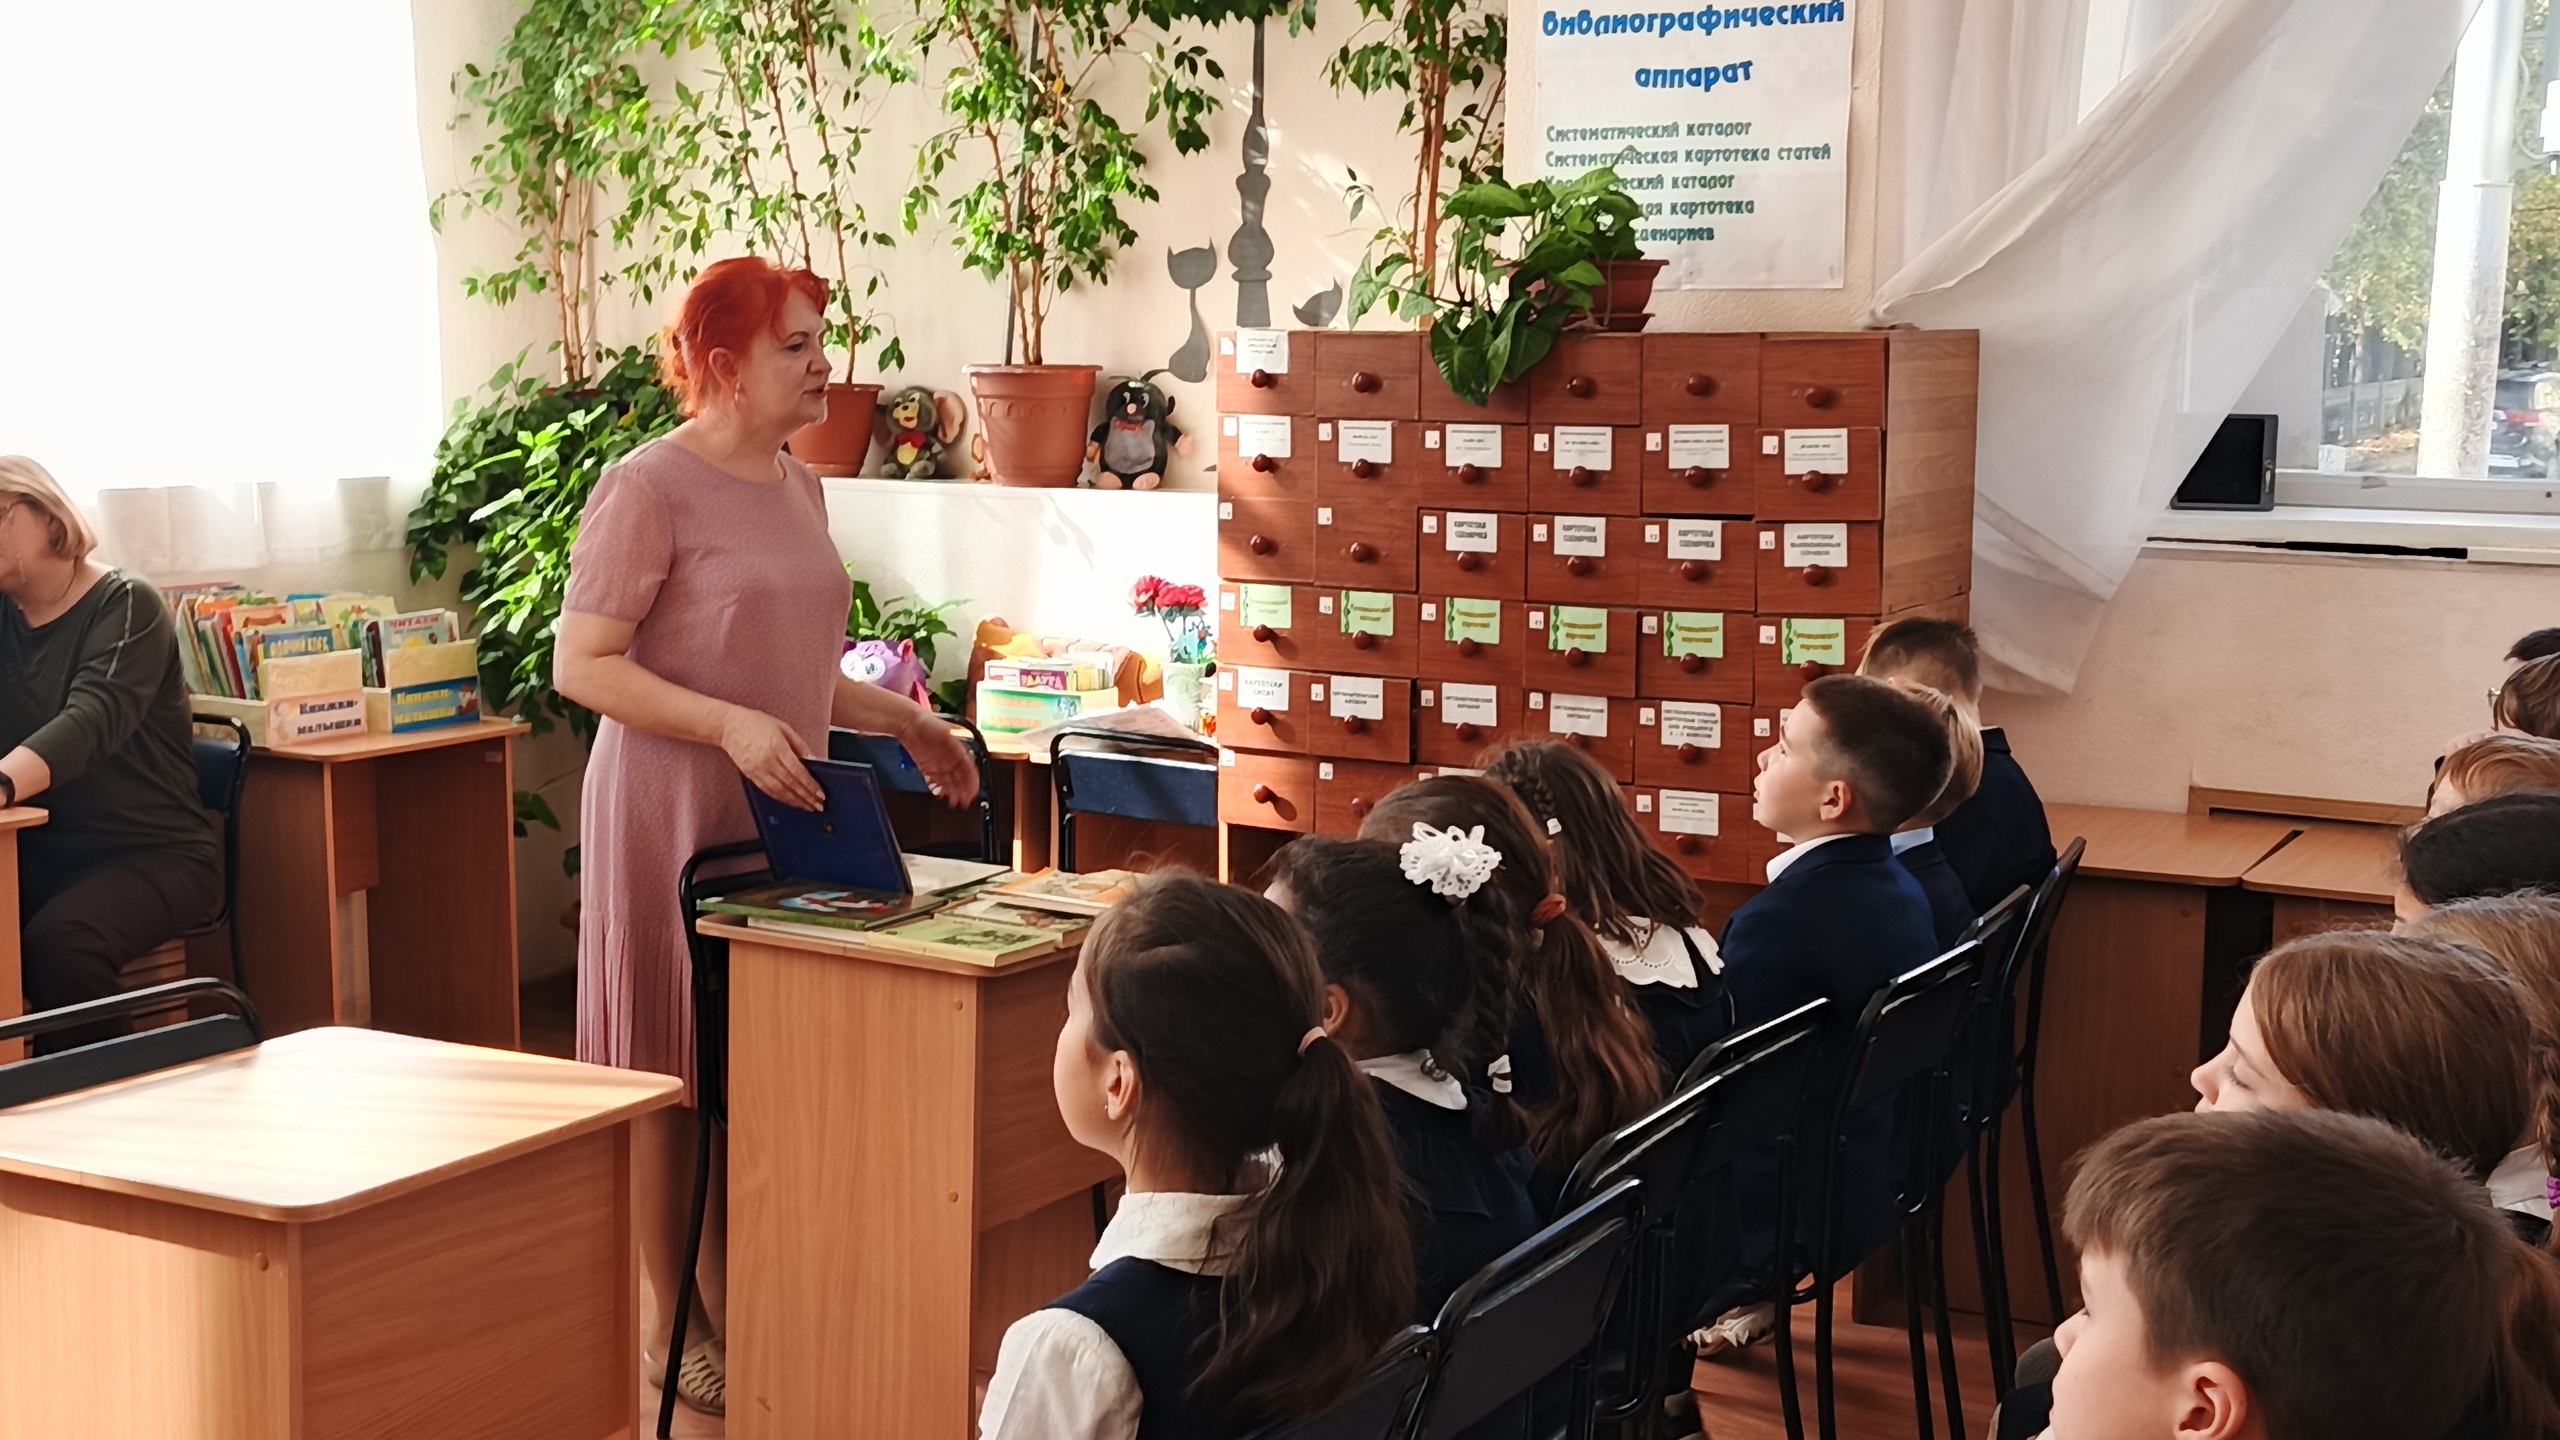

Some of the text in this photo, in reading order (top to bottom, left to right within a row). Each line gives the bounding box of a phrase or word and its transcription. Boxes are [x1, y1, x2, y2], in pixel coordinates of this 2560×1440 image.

[1543, 0, 1844, 38] библиографический
[1635, 60, 1753, 92] аппарат
[1546, 122, 1752, 142] Систематический каталог
[1545, 143, 1831, 167] Систематическая картотека статей
[1671, 175, 1735, 190] каталог
[1670, 200, 1754, 219] картотека
